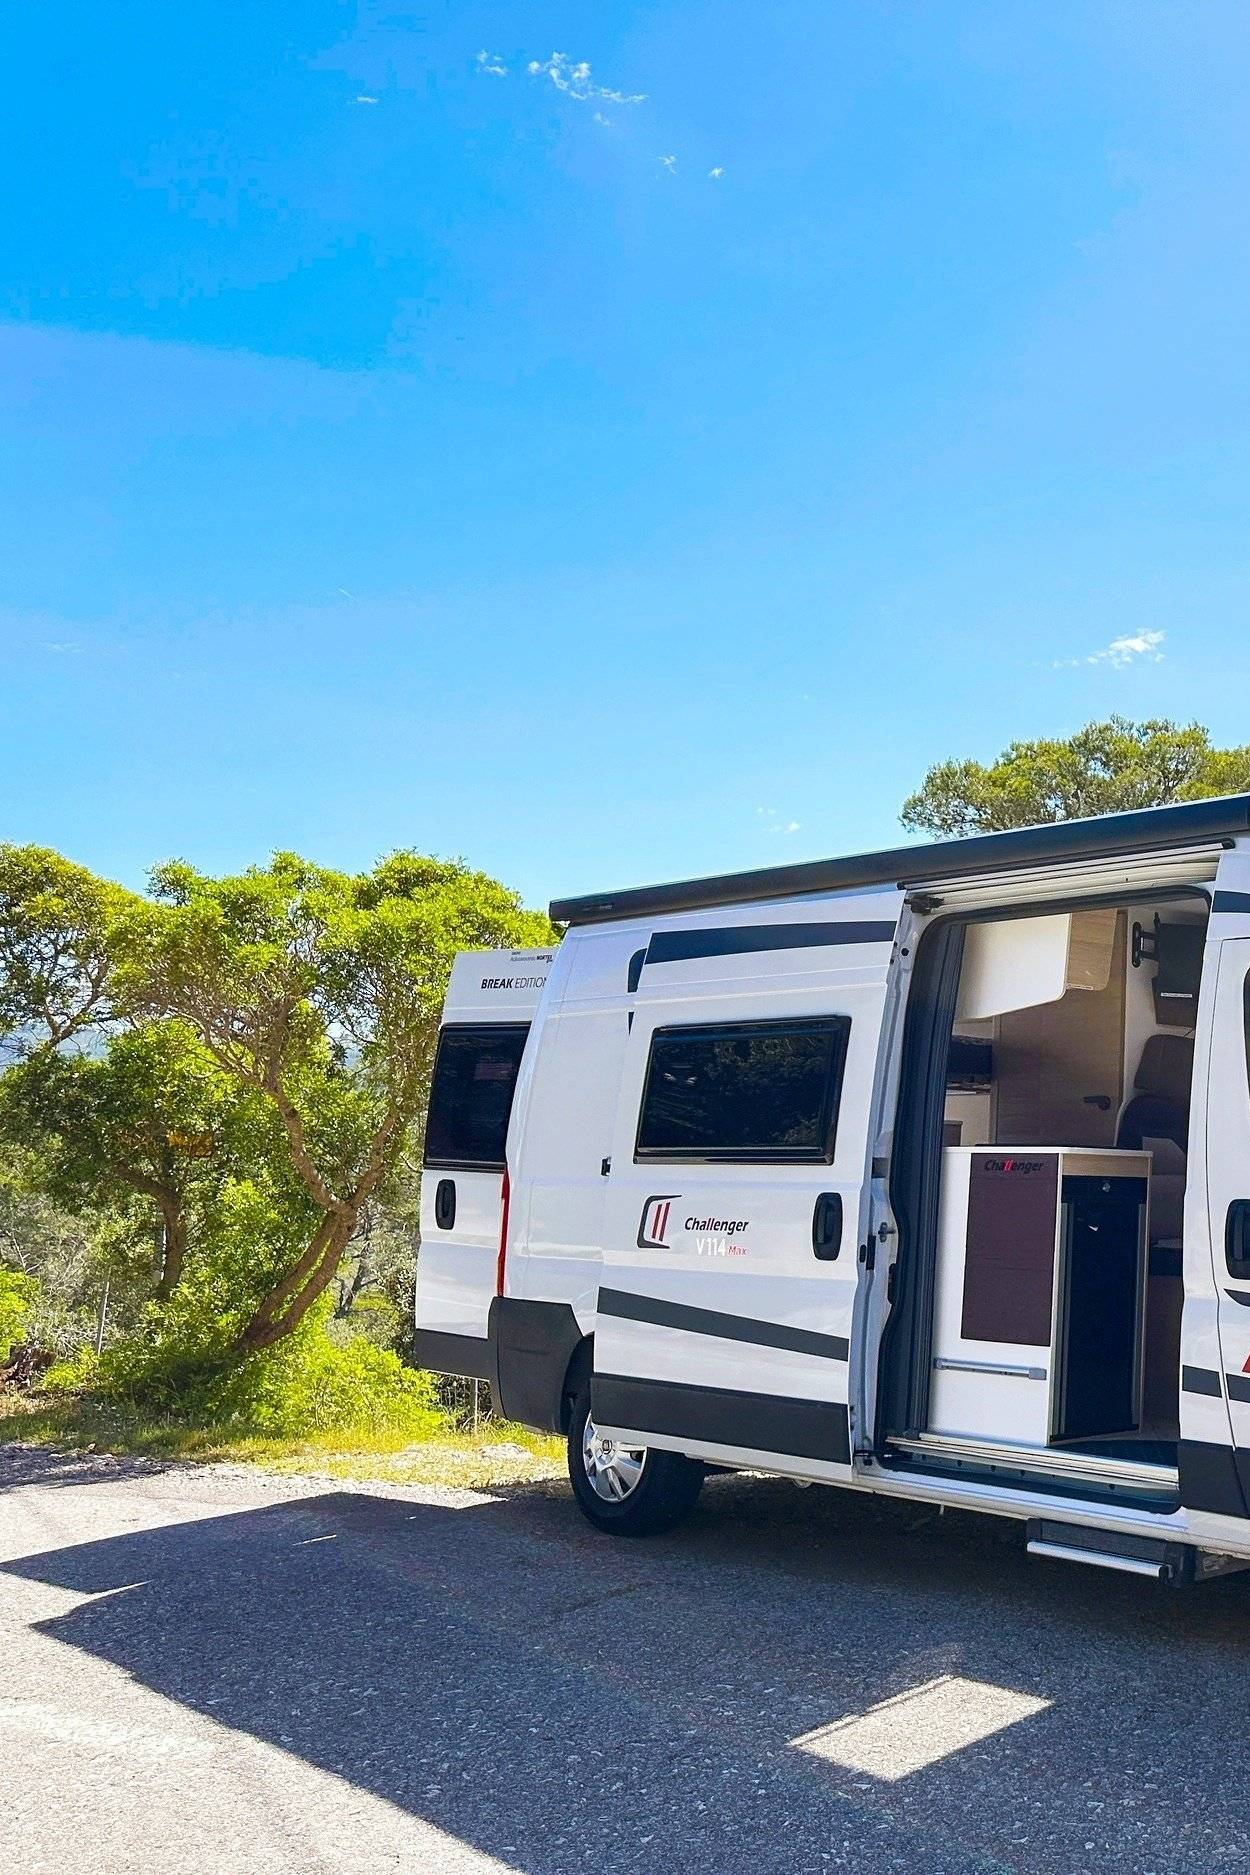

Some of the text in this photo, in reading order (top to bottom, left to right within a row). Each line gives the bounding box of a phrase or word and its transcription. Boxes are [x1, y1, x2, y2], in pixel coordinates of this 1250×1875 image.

[481, 978, 514, 989] BREAK
[983, 1158, 1044, 1176] Challenger
[684, 1217, 749, 1235] Challenger
[696, 1237, 747, 1256] V114 Max
